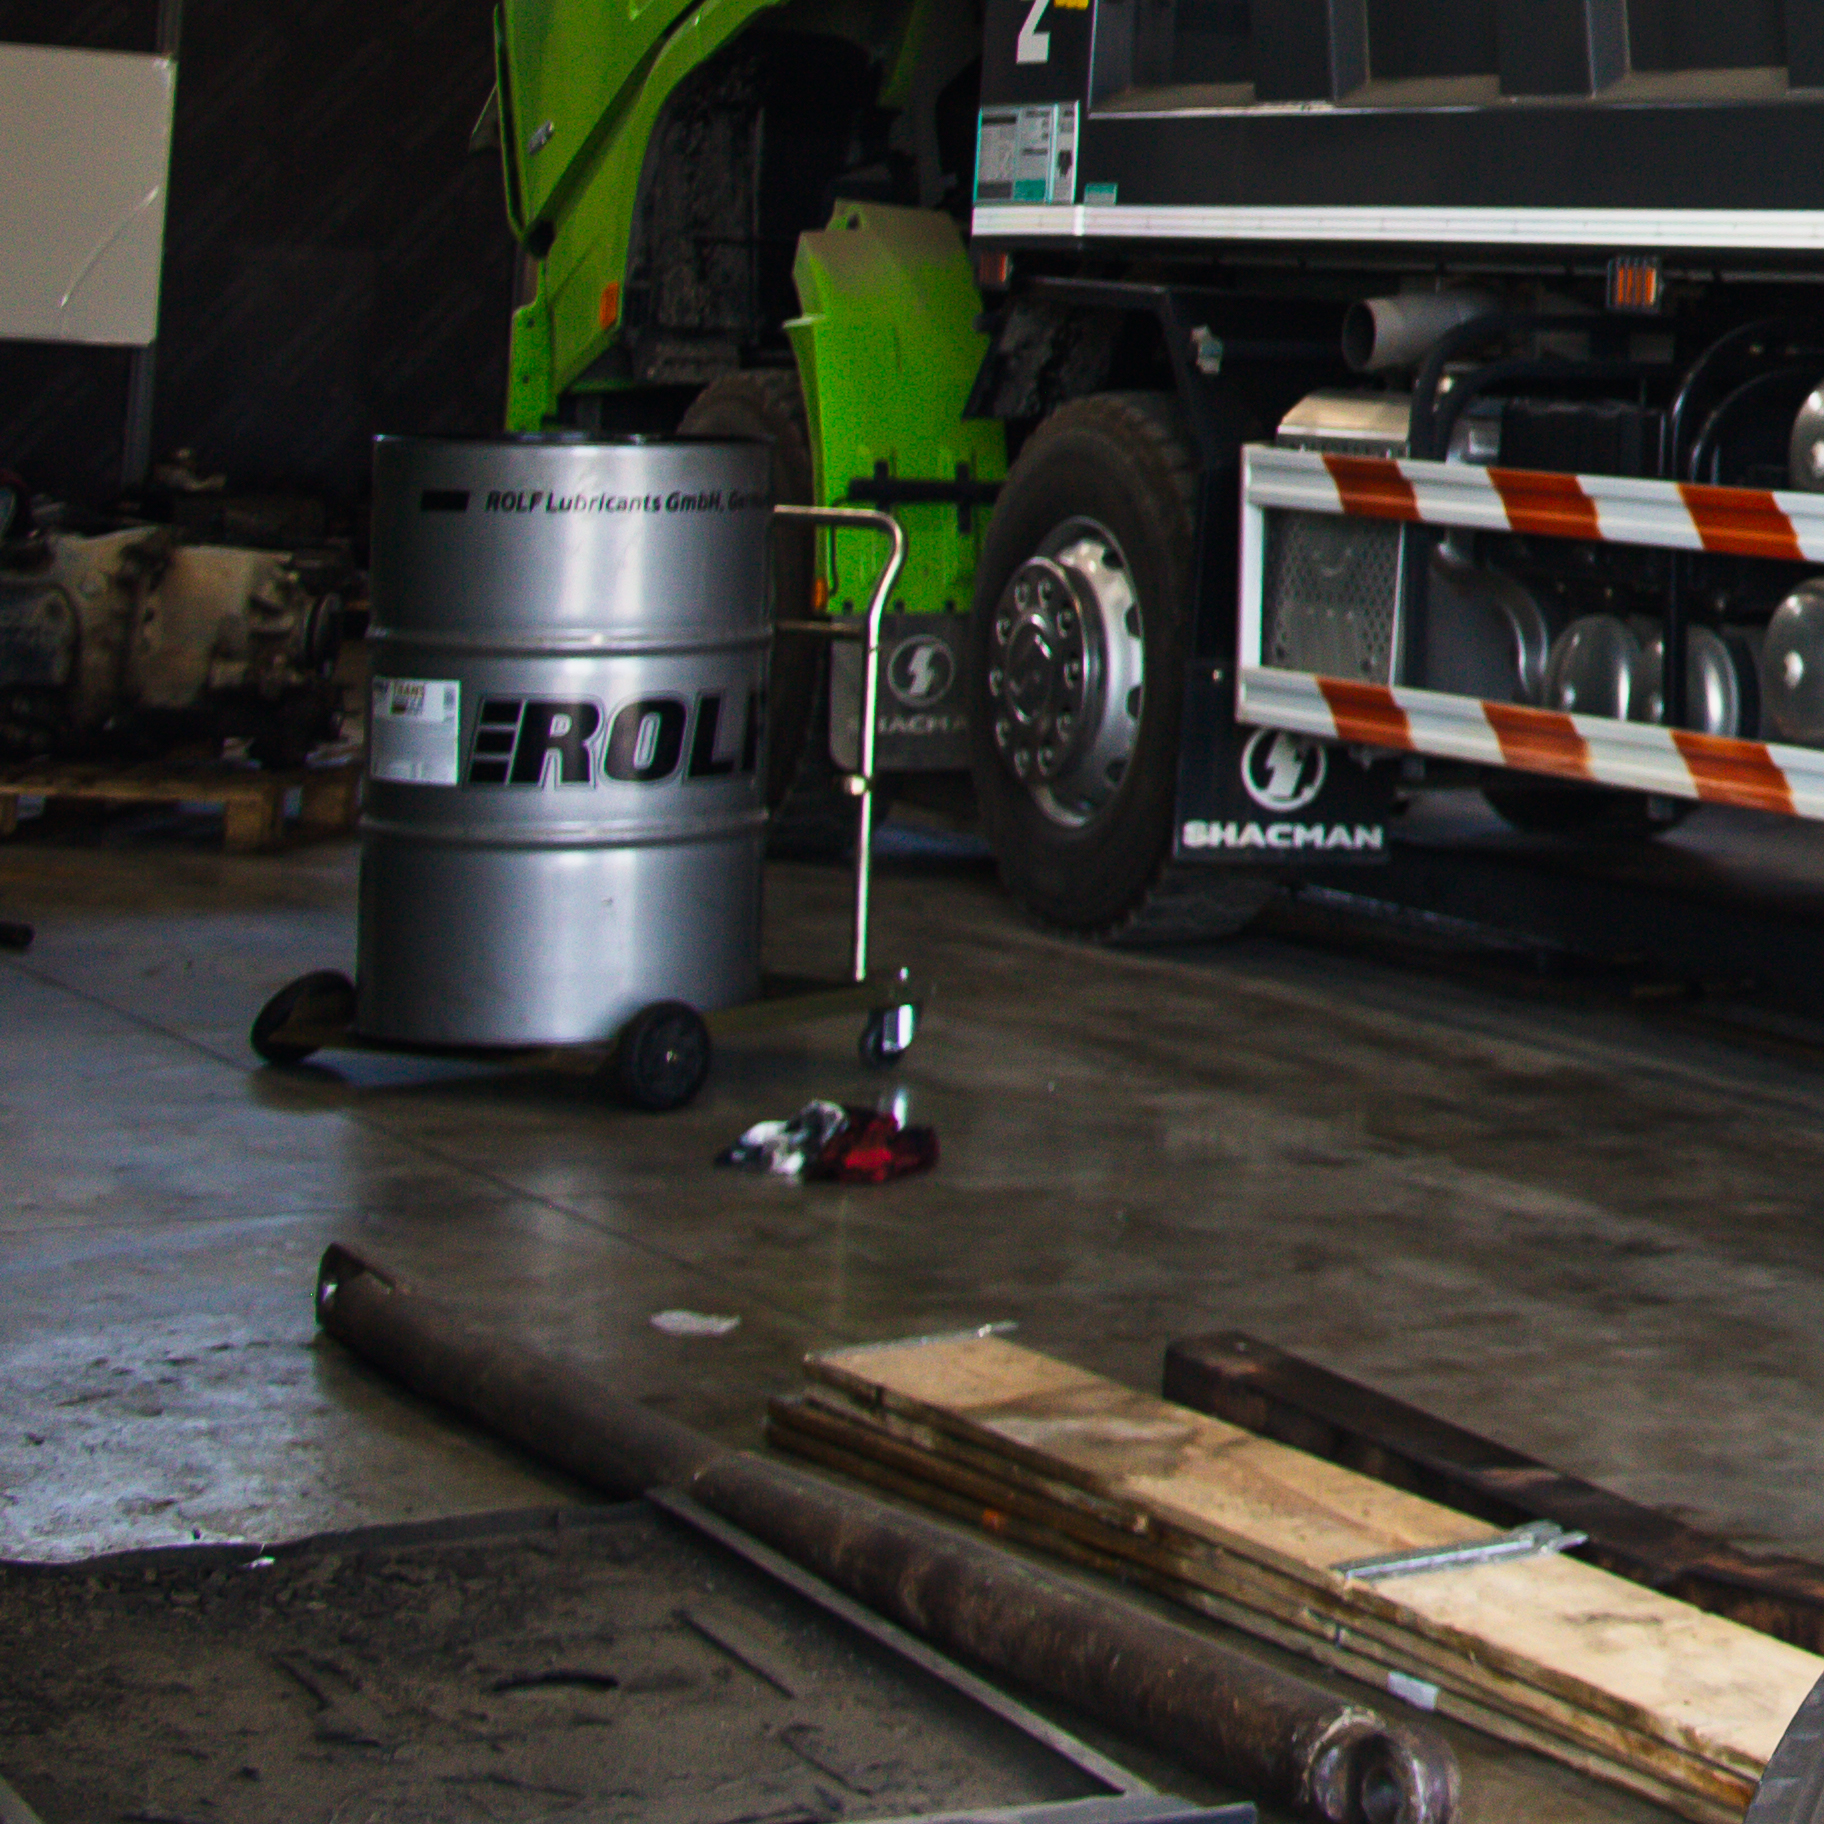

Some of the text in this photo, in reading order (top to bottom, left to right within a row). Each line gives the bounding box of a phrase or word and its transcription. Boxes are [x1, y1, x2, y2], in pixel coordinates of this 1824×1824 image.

[485, 490, 542, 512] ROLF
[547, 491, 660, 513] Lubricants
[1183, 820, 1384, 850] SHACMAN
